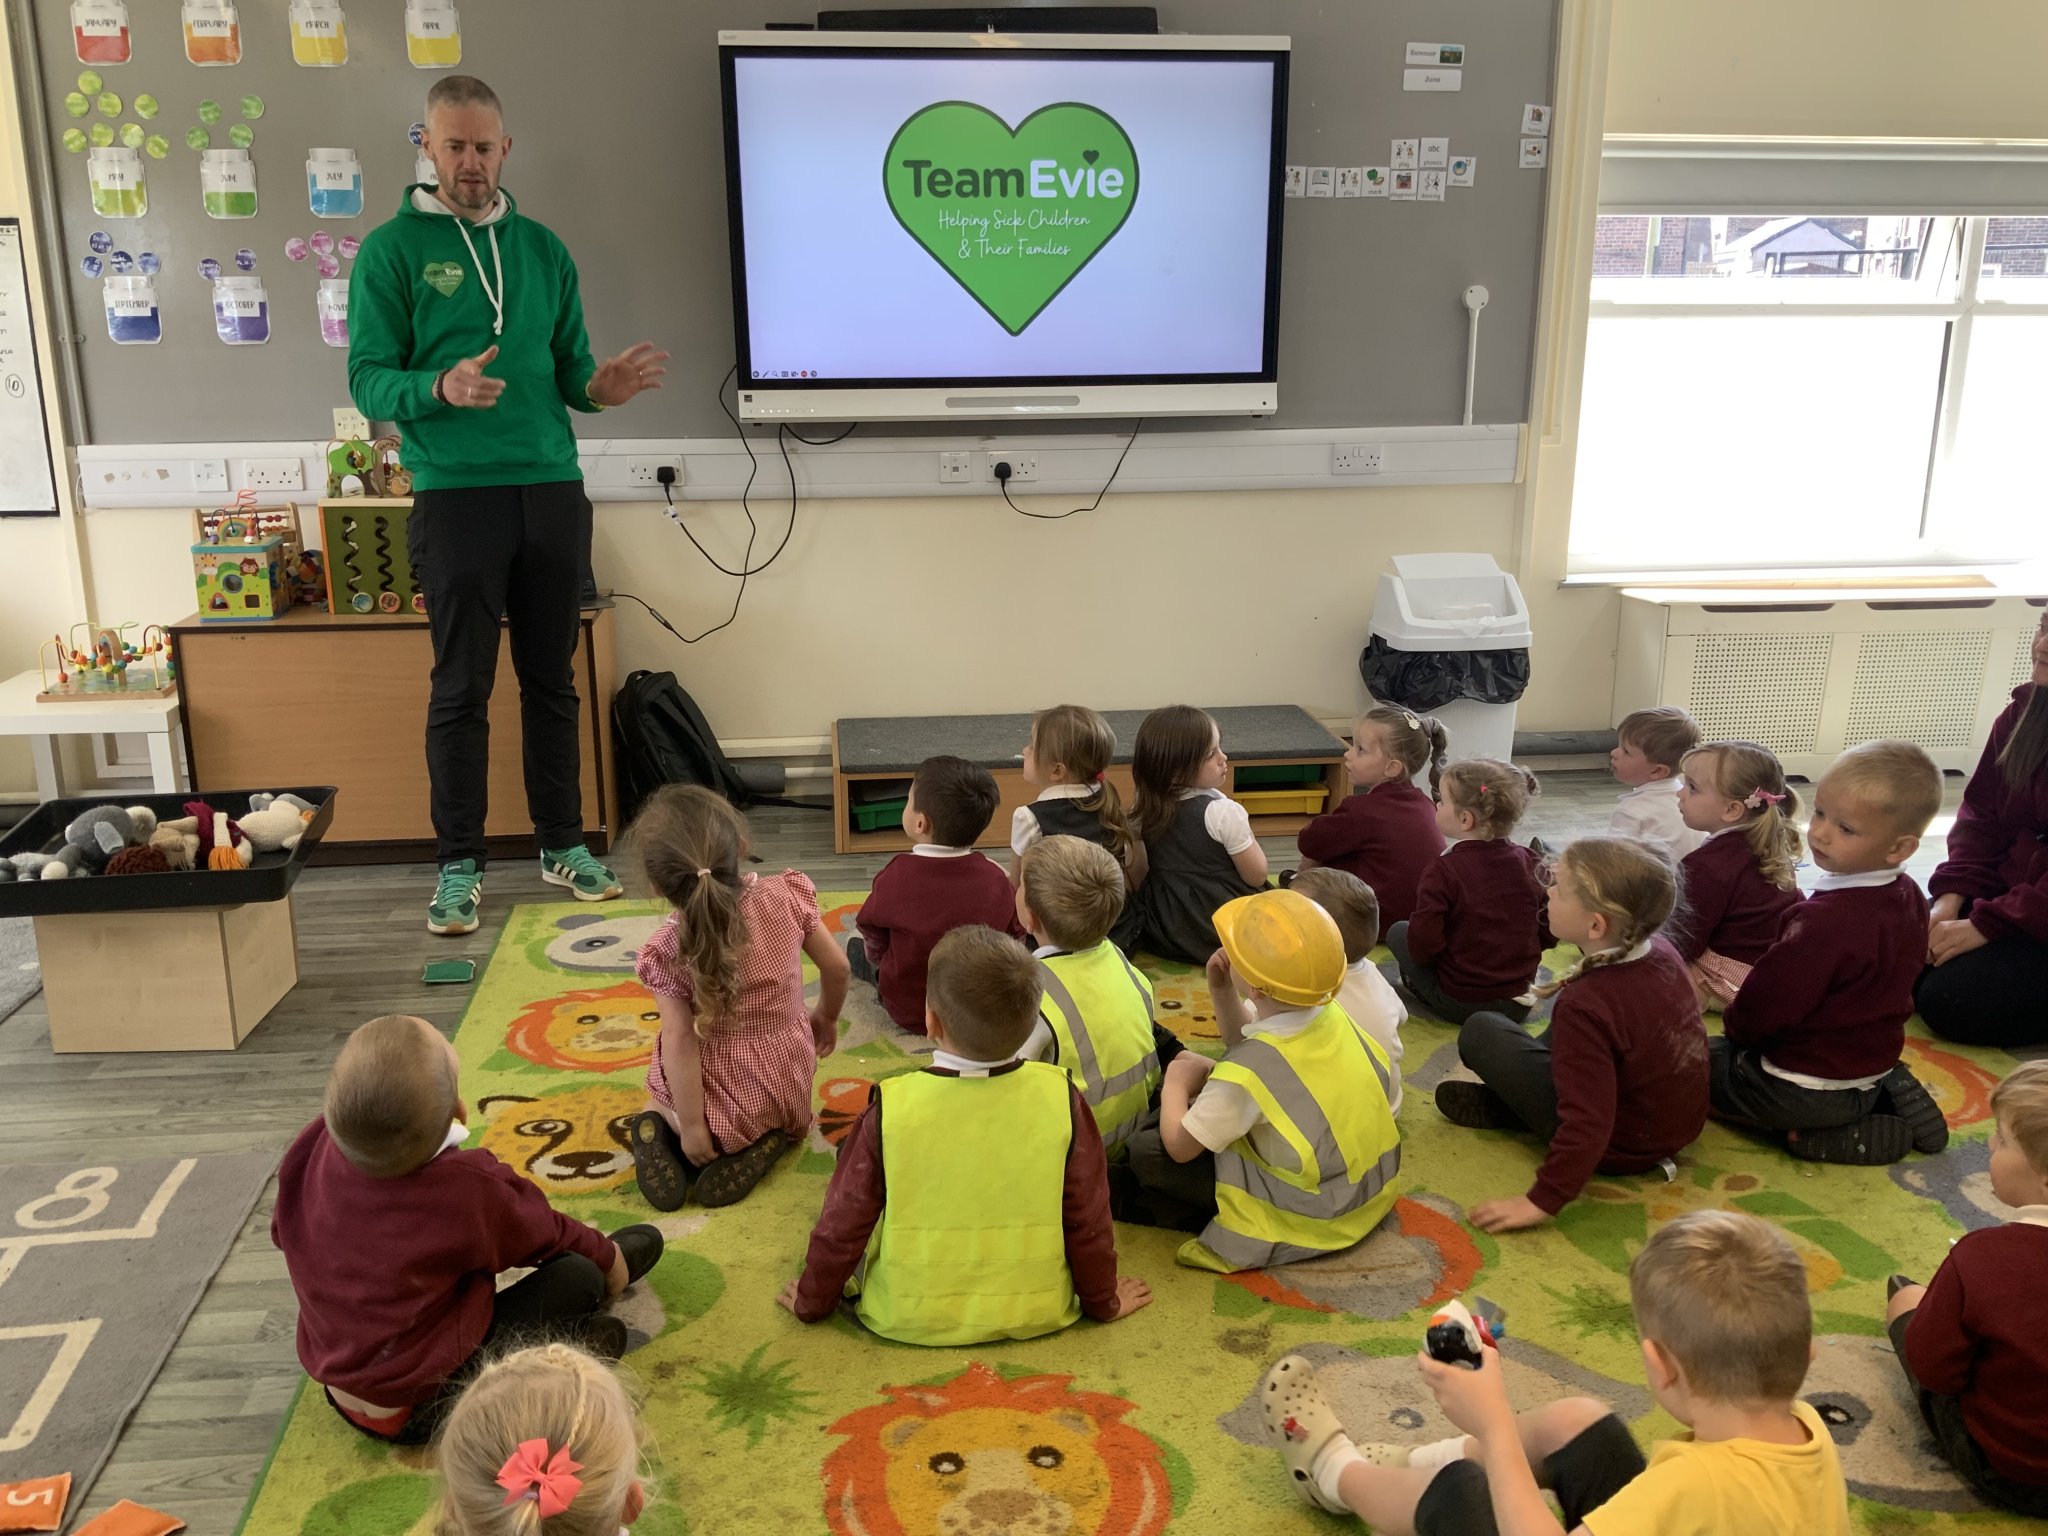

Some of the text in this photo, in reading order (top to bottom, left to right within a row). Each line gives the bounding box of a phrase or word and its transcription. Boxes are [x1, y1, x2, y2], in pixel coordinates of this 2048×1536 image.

[938, 208, 1090, 238] Helping Sick Children
[958, 237, 1071, 258] & Their Families
[14, 1166, 119, 1229] 8
